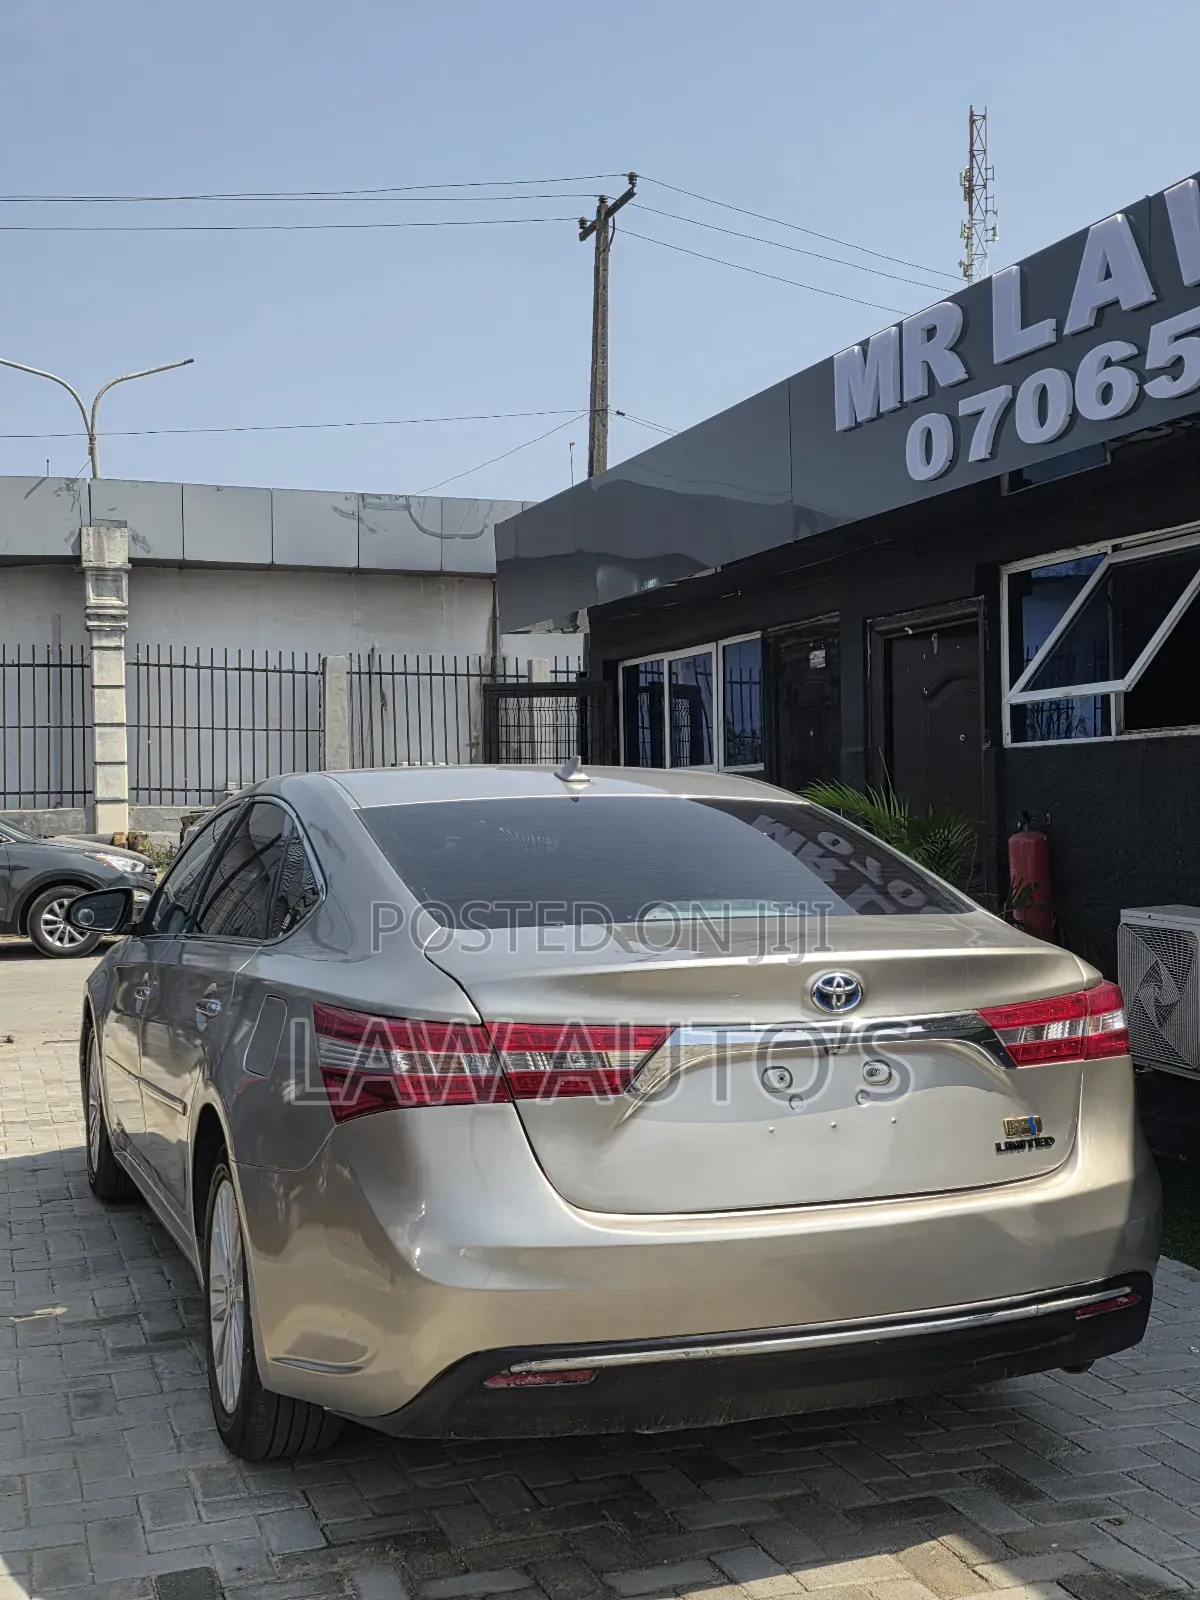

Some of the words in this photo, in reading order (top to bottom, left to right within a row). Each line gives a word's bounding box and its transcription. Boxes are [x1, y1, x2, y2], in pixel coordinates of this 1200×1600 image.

[834, 302, 969, 432] MR
[905, 306, 1200, 481] 07065
[995, 1136, 1055, 1154] LIMITED
